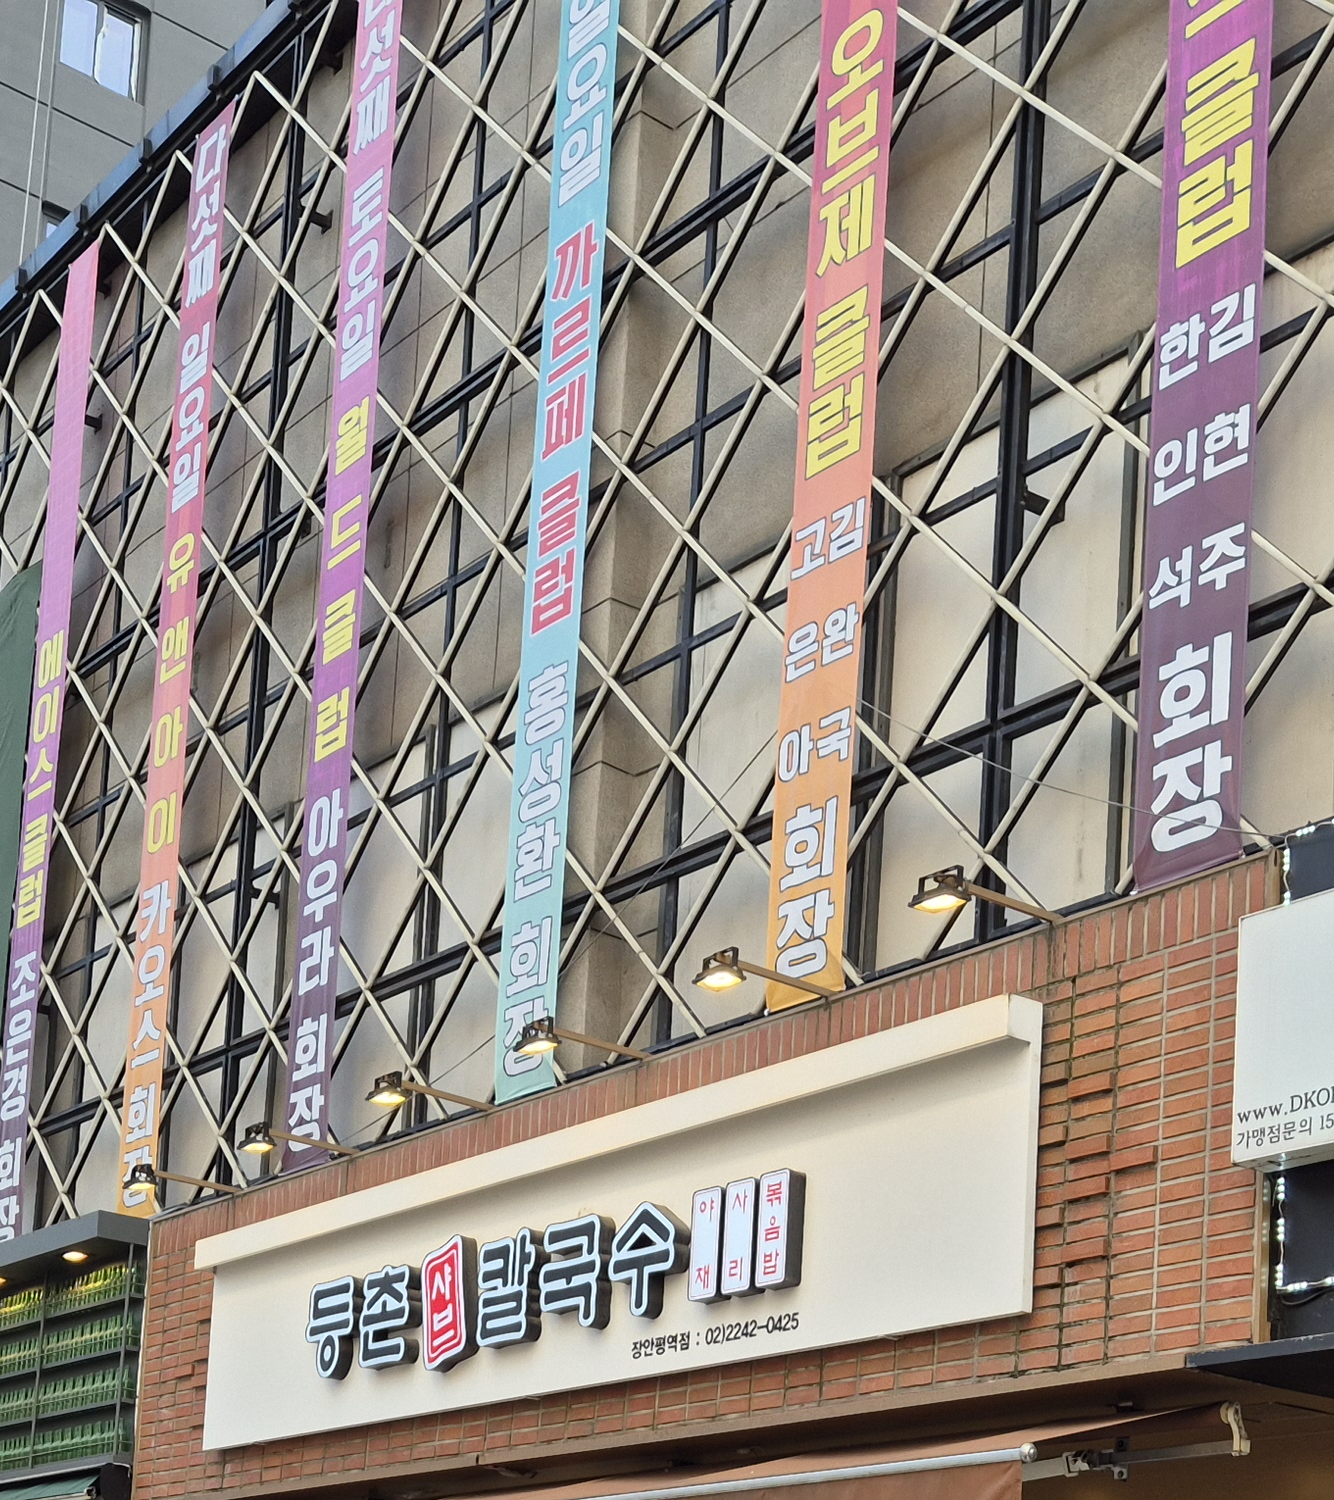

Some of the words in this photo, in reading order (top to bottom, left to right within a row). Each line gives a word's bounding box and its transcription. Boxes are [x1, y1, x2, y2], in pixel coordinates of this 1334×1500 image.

[353, 0, 398, 157] 섯째
[816, 10, 881, 278] 오브제
[185, 130, 228, 309] 다섯째
[338, 172, 384, 383] 토요일
[171, 332, 210, 512] 일요일
[804, 283, 868, 480] 클럽
[530, 470, 581, 635] 클럽
[513, 662, 571, 900] 홍성환
[1149, 631, 1233, 853] 회장
[131, 880, 171, 1070] 카오스
[298, 788, 344, 996] 아우라
[774, 792, 839, 979] 회장
[0, 949, 37, 1124] 조은경
[287, 1015, 330, 1152] 회장
[1236, 1116, 1313, 1149] 가맹점문의
[763, 1180, 782, 1276] 볶음밥
[632, 1330, 691, 1360] 장안평역점
[705, 1312, 800, 1346] 02)2242-0425
